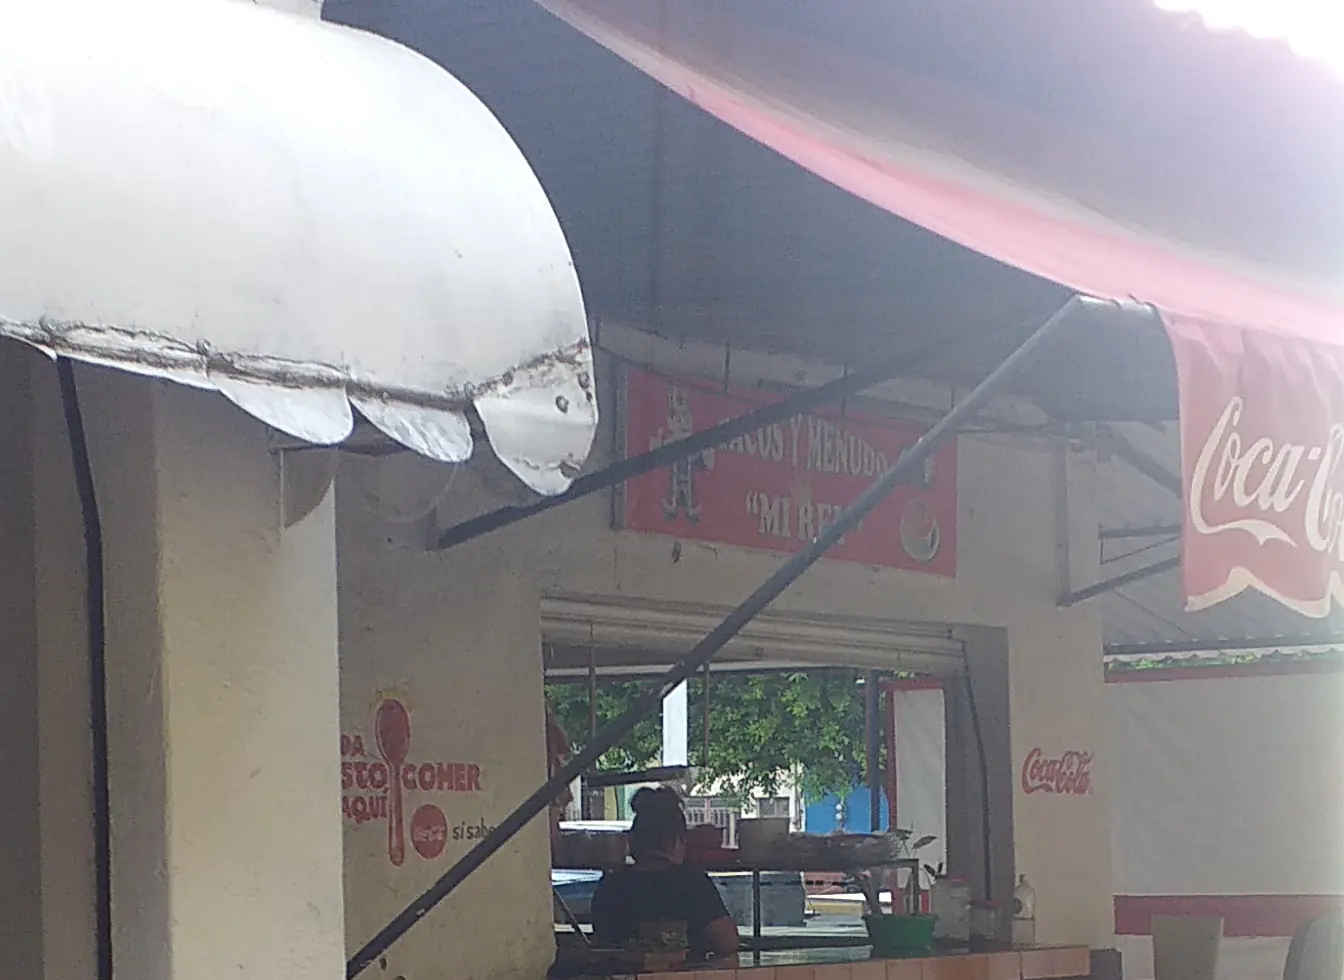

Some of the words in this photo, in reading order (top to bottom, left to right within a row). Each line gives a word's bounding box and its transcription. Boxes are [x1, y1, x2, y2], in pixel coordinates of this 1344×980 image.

[720, 420, 784, 462] ACOS
[789, 413, 804, 468] Y
[341, 762, 389, 790] STO
[401, 762, 482, 792] COMER
